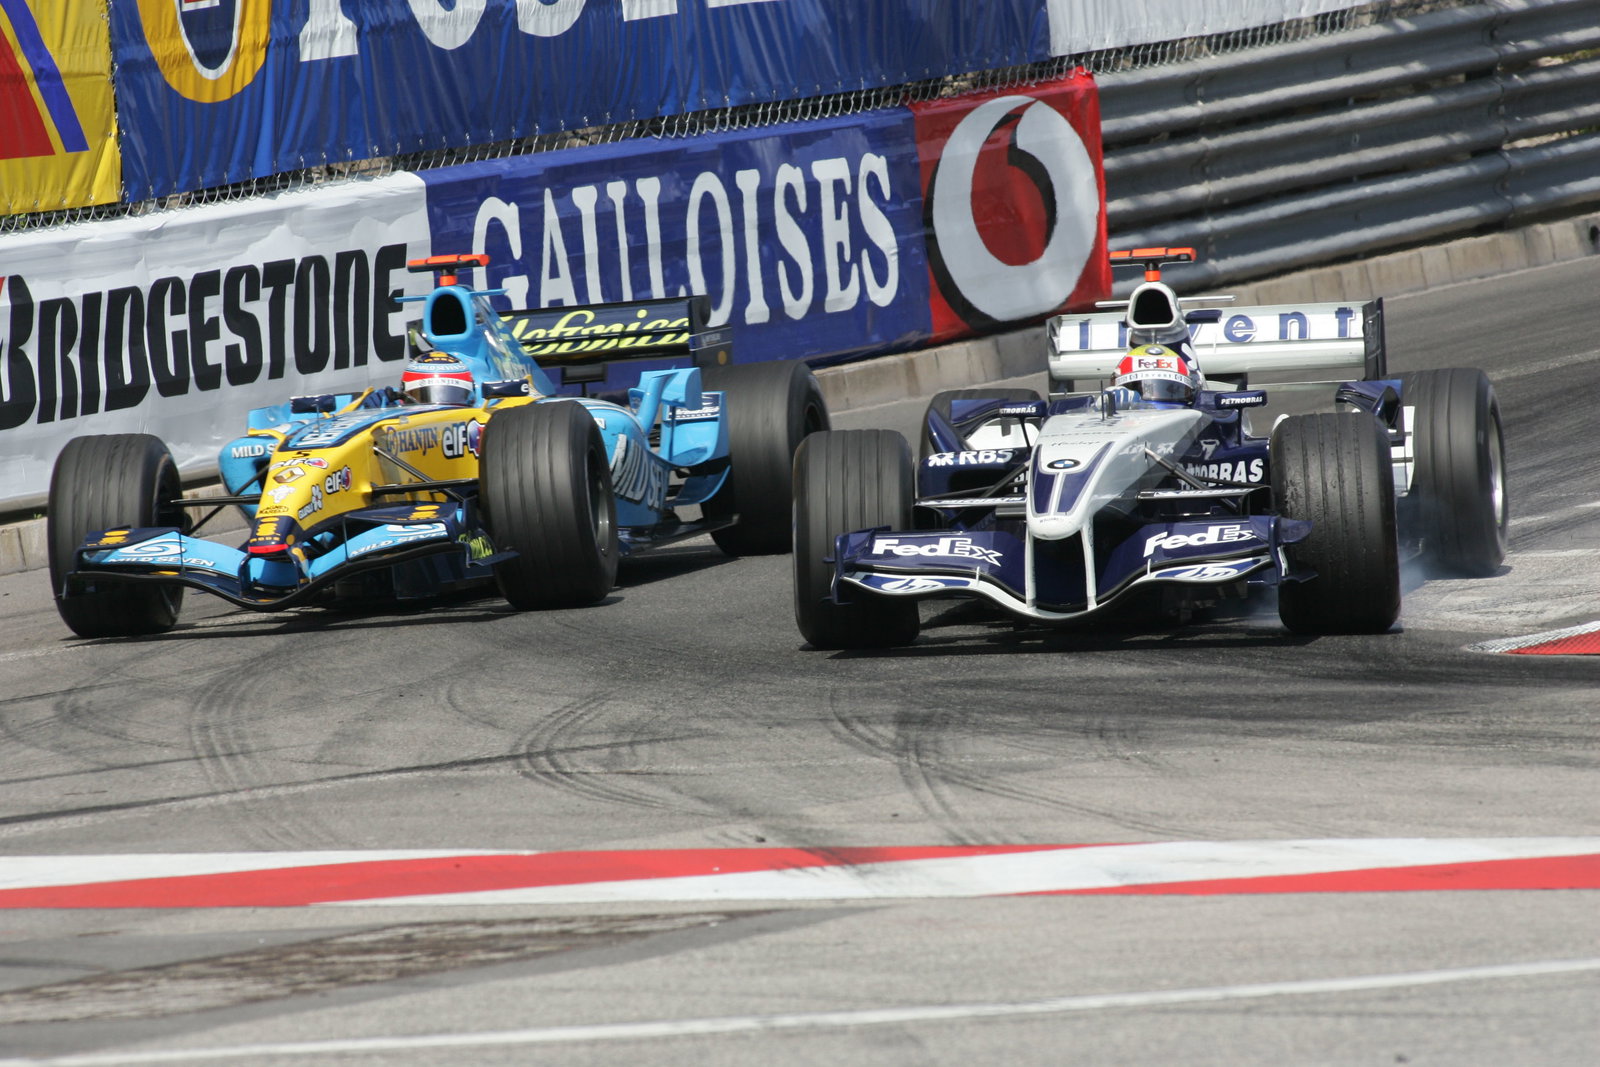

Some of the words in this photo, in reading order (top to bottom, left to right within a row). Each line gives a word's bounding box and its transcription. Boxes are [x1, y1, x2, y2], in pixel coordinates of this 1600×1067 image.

[472, 153, 898, 327] GAULOISES
[0, 243, 408, 430] BRIDGESTONE
[1079, 307, 1356, 350] ient
[1138, 359, 1172, 369] FedEx
[232, 445, 264, 458] MILD
[400, 427, 439, 456] HANJIN
[443, 424, 467, 458] elf
[959, 449, 1012, 466] RBS
[325, 471, 341, 494] elf
[351, 539, 394, 557] MILD
[872, 537, 1003, 567] FedEx
[1143, 525, 1257, 557] FedEx
[156, 556, 216, 568] SEVEN
